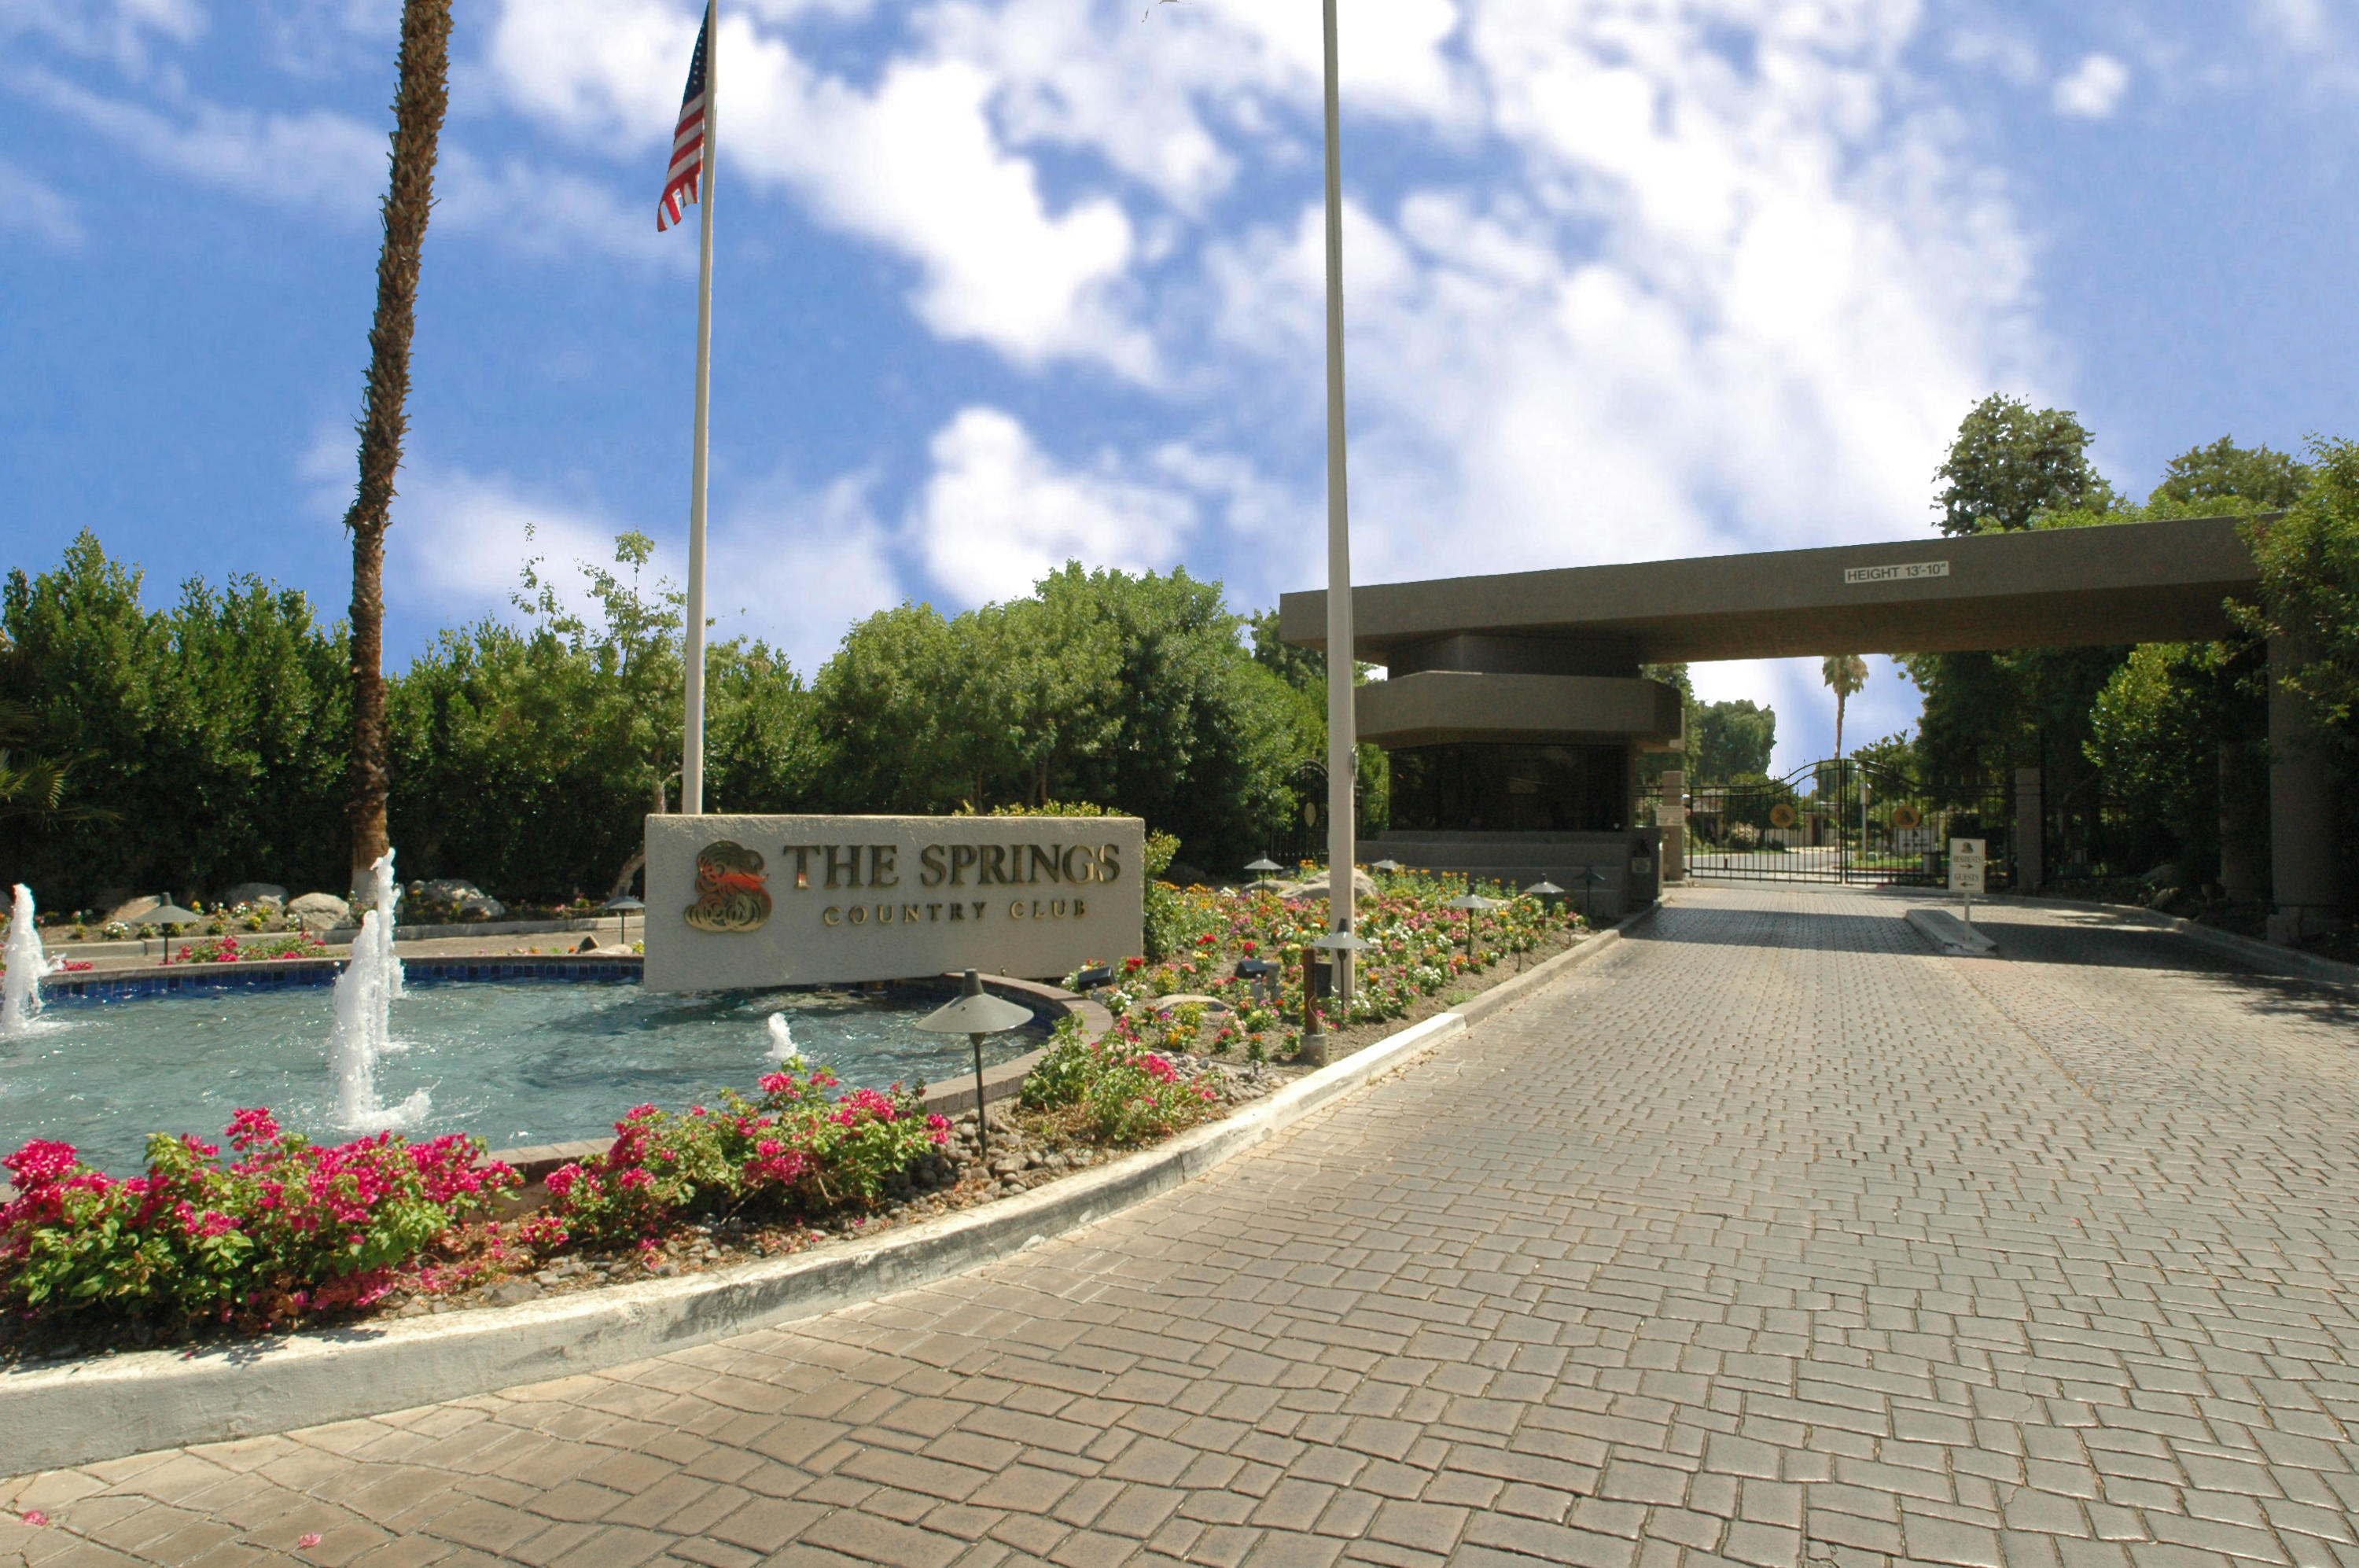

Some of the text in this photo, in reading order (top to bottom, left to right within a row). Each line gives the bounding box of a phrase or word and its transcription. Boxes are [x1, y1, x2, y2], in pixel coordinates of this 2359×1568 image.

[1848, 567, 1900, 581] HEIGHT
[783, 843, 1121, 889] THE SPRINGS
[1953, 855, 1982, 863] RESIDENTS
[823, 900, 1087, 925] COUNTRY CLUB
